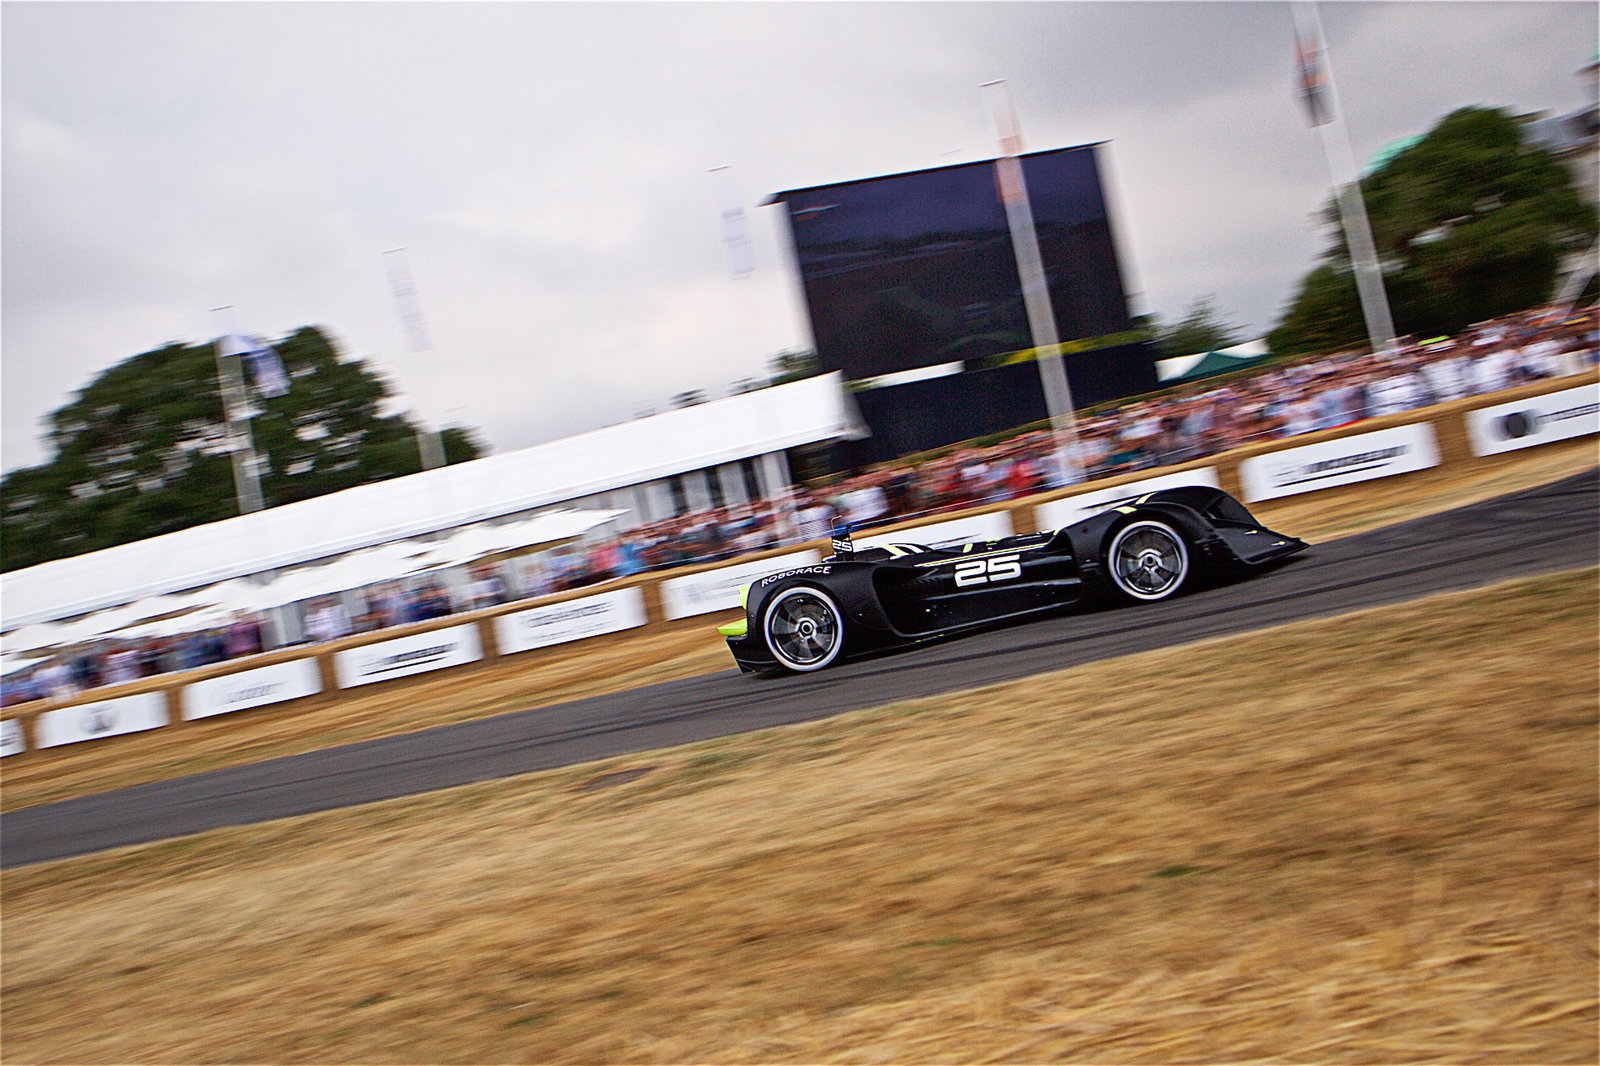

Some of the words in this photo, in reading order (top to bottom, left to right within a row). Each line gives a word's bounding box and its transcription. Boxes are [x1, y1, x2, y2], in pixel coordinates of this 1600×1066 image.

[832, 539, 852, 552] 25
[761, 566, 832, 588] ROBORACE
[954, 554, 1022, 588] 25
